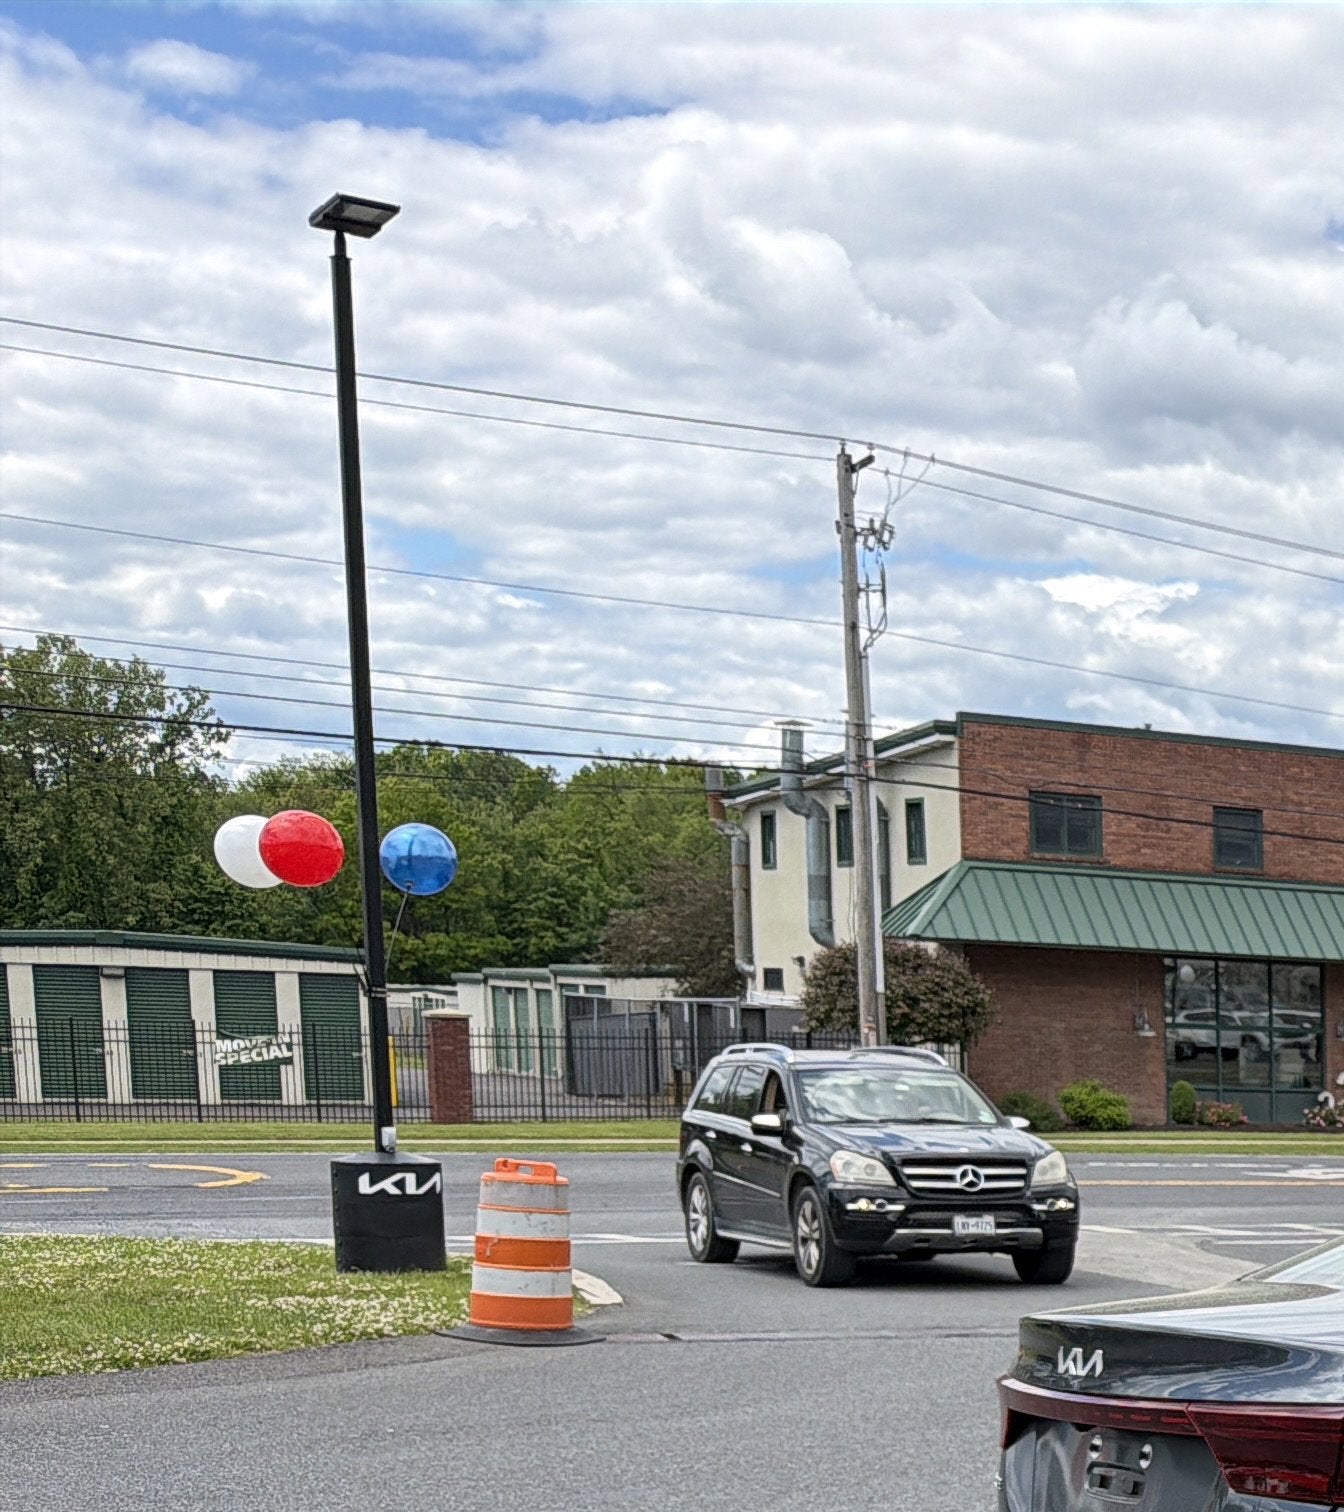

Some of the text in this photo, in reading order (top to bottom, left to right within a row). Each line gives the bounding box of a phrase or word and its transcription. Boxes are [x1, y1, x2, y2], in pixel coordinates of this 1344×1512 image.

[215, 1043, 293, 1066] SPECIAL
[358, 1171, 441, 1195] KIA
[1057, 1345, 1104, 1378] KIA
